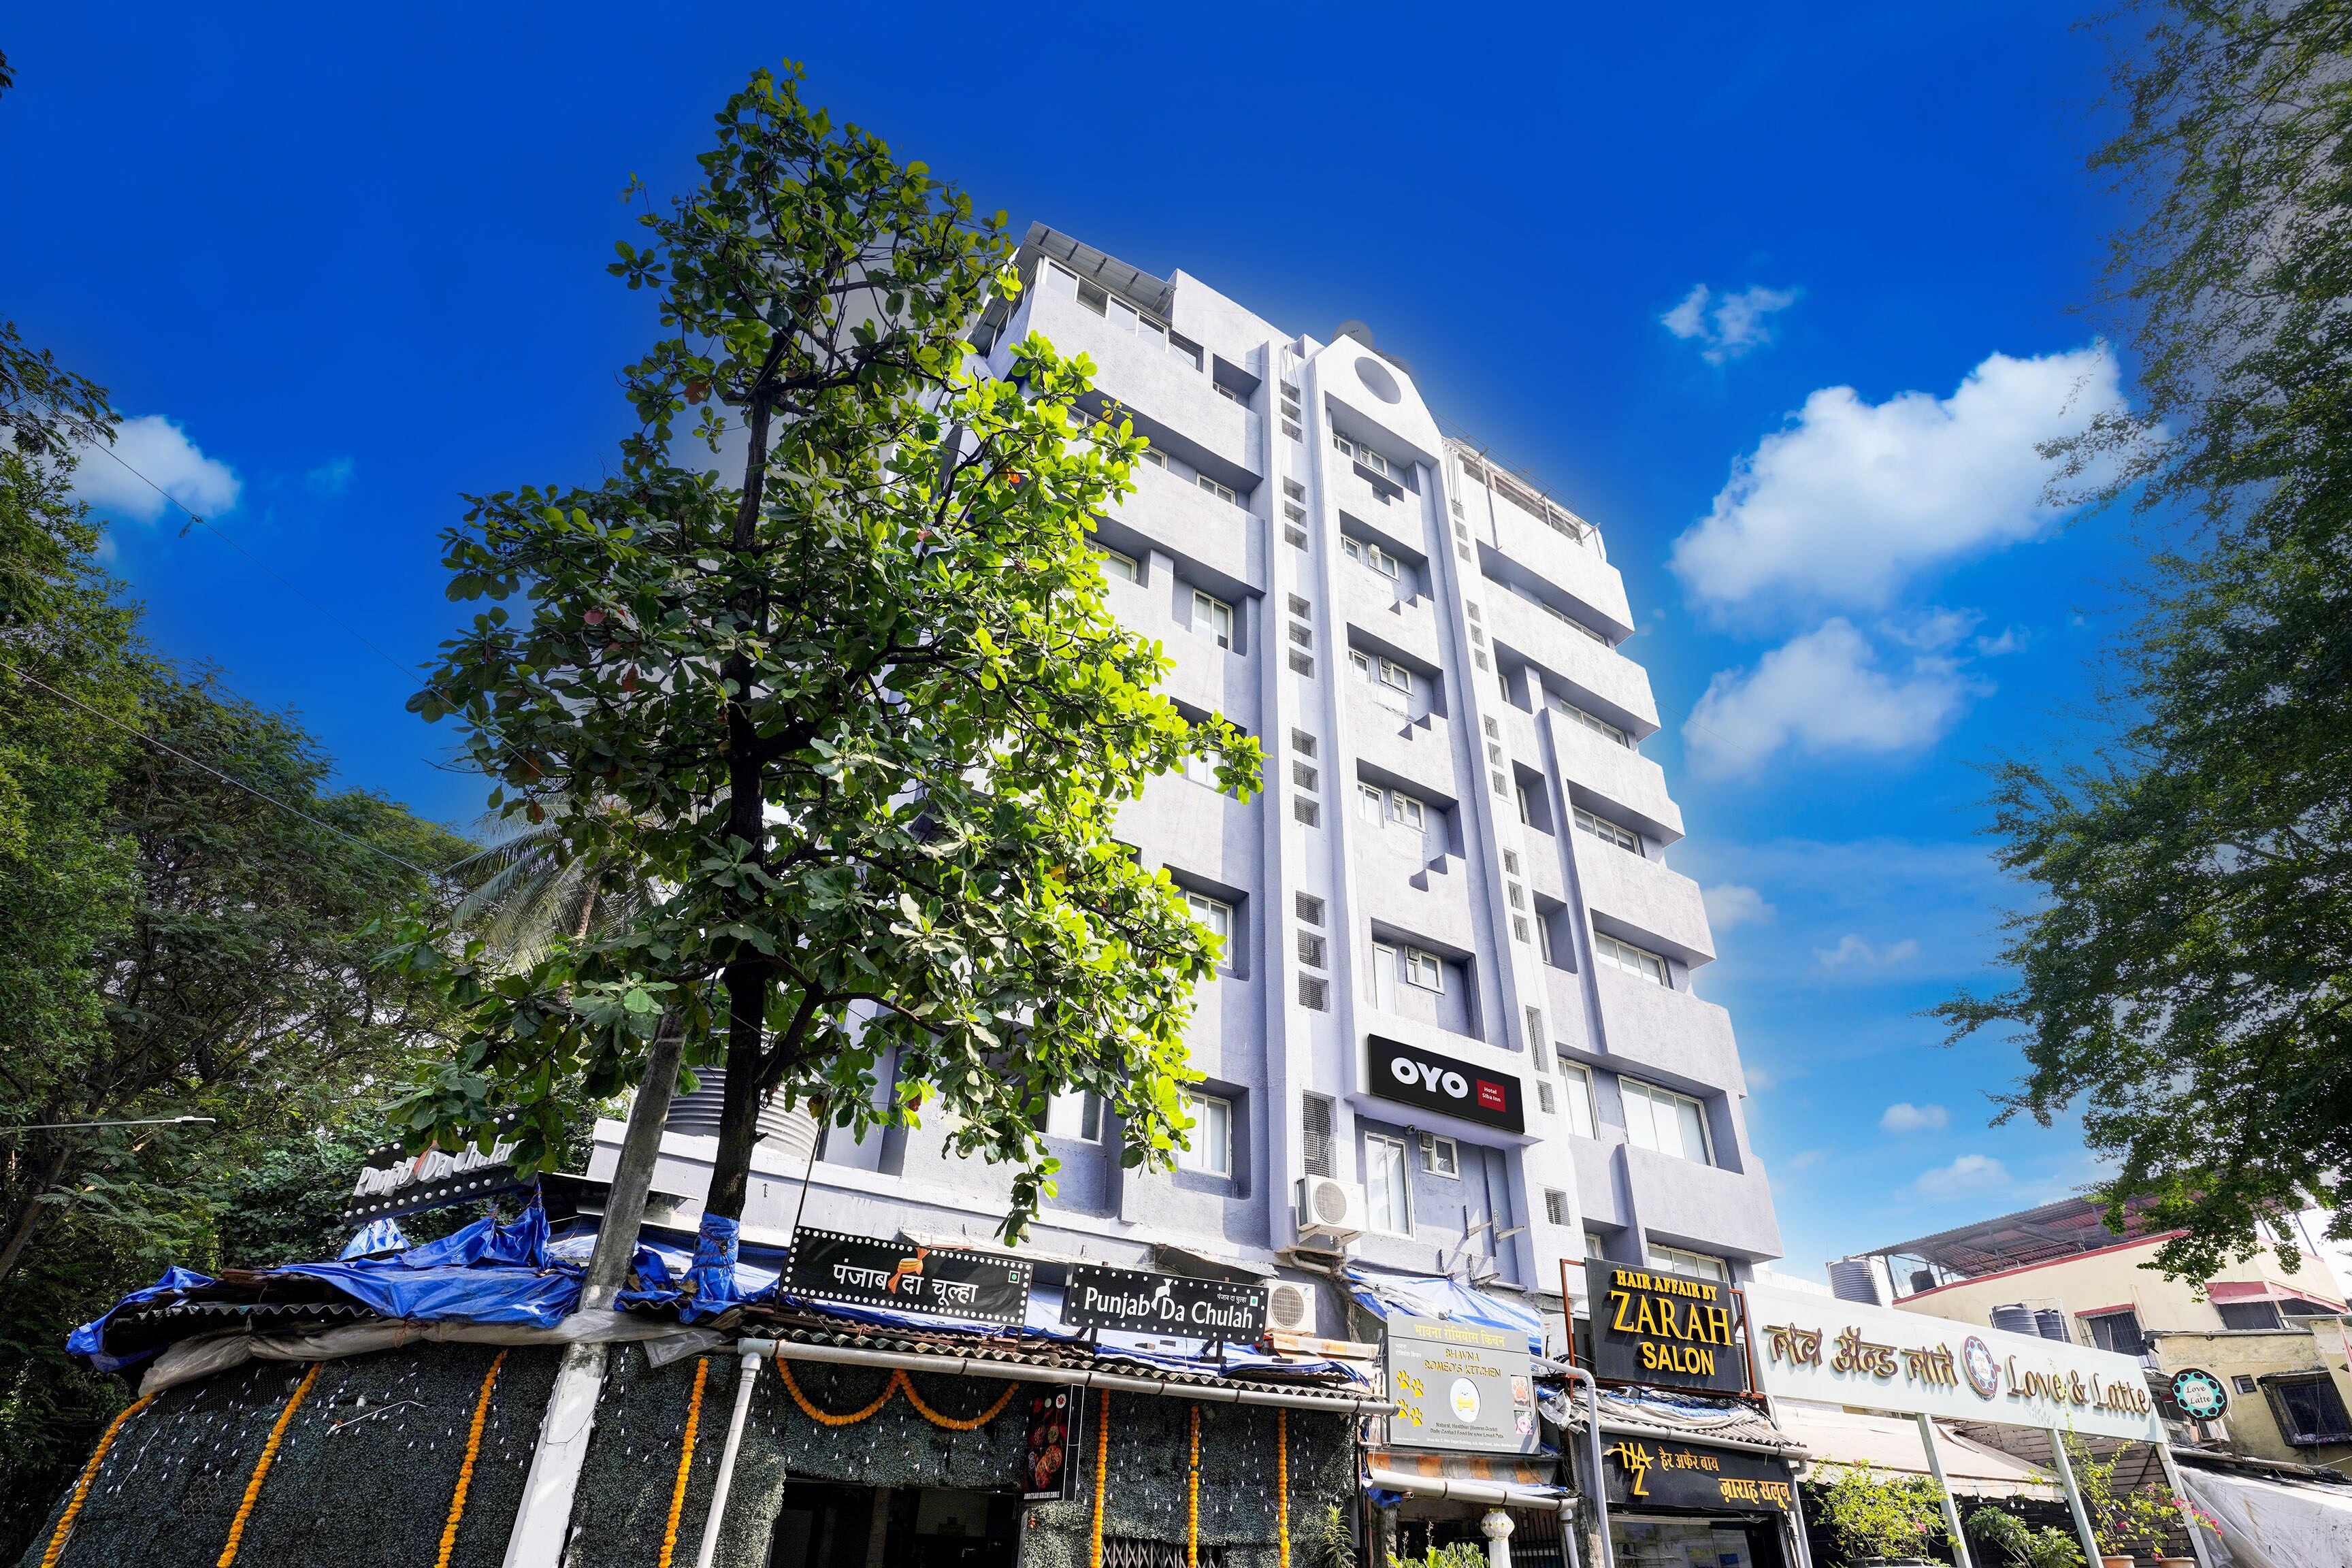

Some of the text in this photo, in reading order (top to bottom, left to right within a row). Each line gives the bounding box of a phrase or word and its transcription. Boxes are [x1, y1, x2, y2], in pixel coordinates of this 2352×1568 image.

[1390, 1057, 1469, 1098] OYO
[1484, 1087, 1497, 1095] Hotel
[353, 1156, 418, 1197] Punjab
[420, 1150, 455, 1183] Da
[833, 1258, 979, 1307] पंजाब दा चूल्हा
[1217, 1292, 1229, 1301] पंजाब
[1614, 1269, 1717, 1301] HAIR AFFAIR BY
[1084, 1286, 1253, 1328] Punjab Da Chulah
[1610, 1290, 1733, 1346] ZARAH
[1414, 1324, 1505, 1347] भावना रोमियोस किचन
[1424, 1360, 1501, 1377] ROMEO'S KITCHEN
[1446, 1348, 1480, 1362] BHAVNA
[1641, 1341, 1715, 1375] SALON
[1763, 1322, 1823, 1367] लव
[1900, 1341, 1959, 1387] लाते
[2005, 1354, 2152, 1414] Love & Latte
[1658, 1446, 1674, 1471] हैर
[1699, 1456, 1720, 1471] बाय
[1718, 1477, 1792, 1510] ज़ाराह सलून
